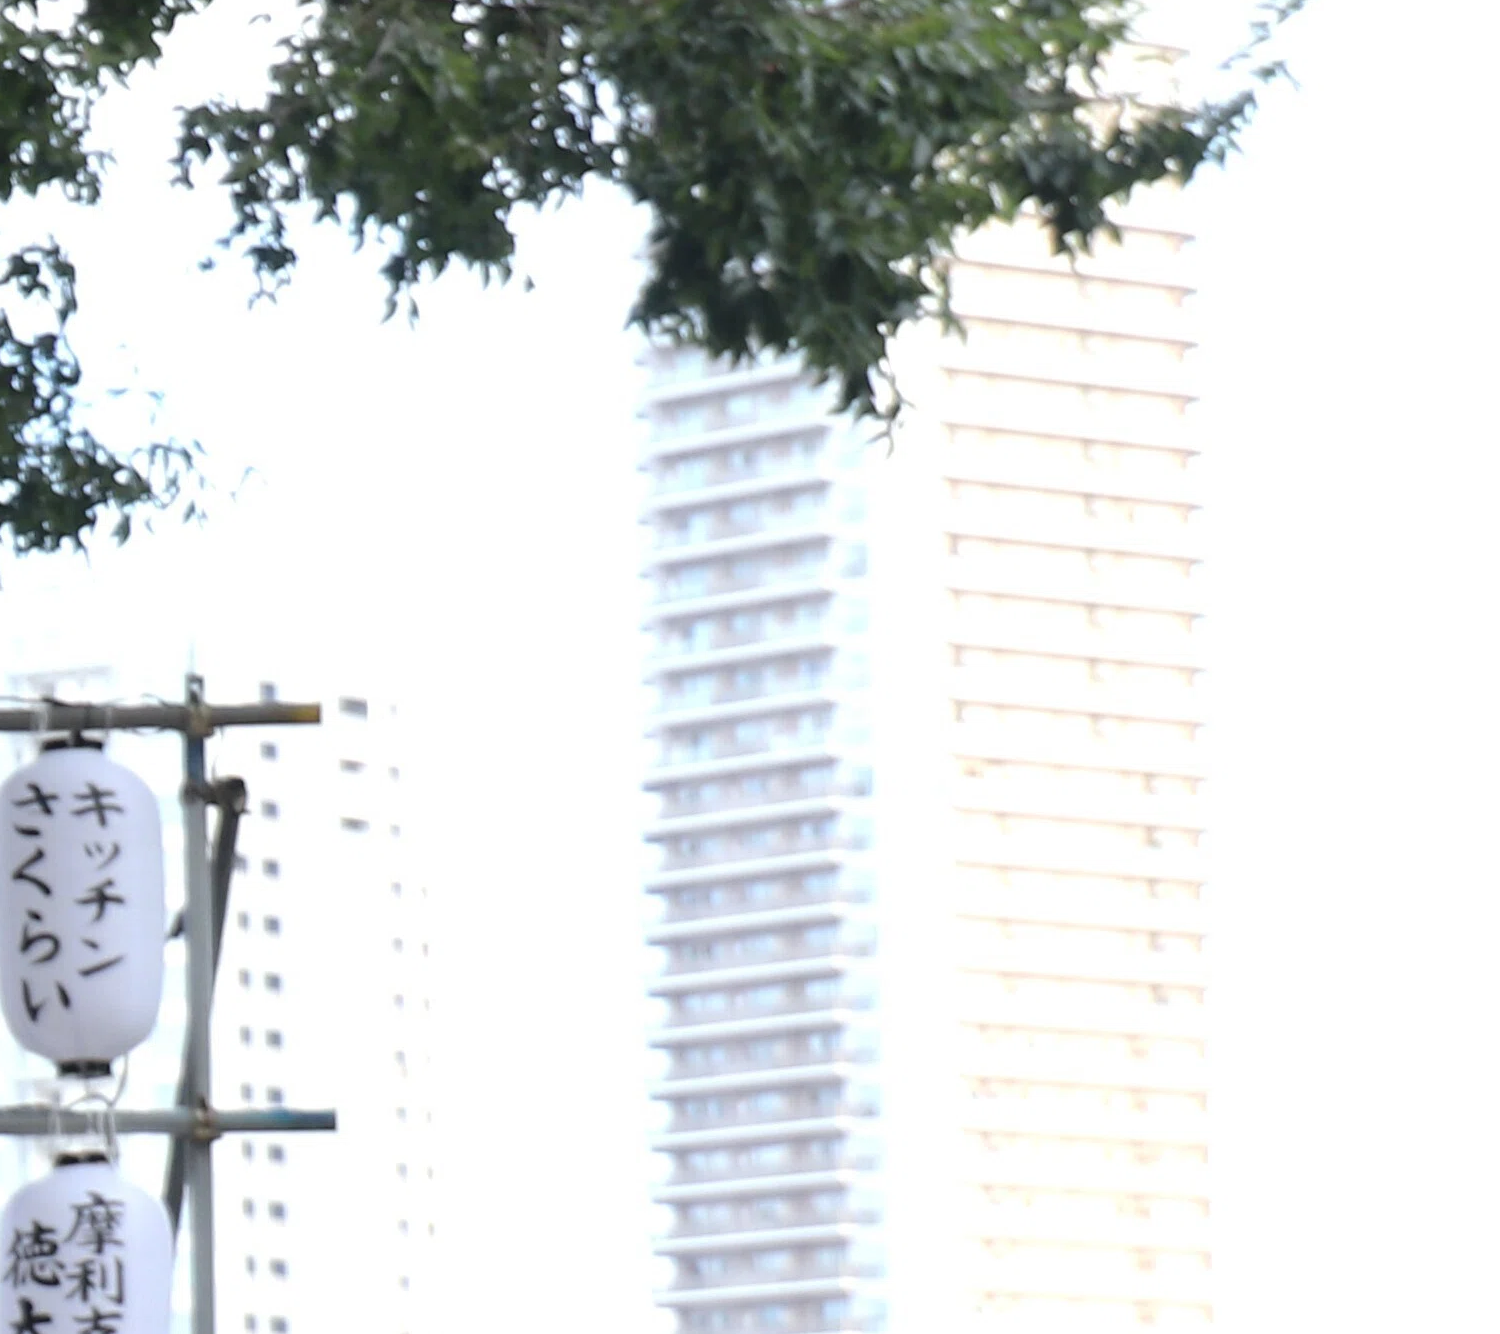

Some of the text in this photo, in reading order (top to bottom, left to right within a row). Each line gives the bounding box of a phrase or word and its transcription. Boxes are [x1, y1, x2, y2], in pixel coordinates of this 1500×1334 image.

[12, 783, 71, 1023] さくらい
[73, 784, 125, 977] キッチン
